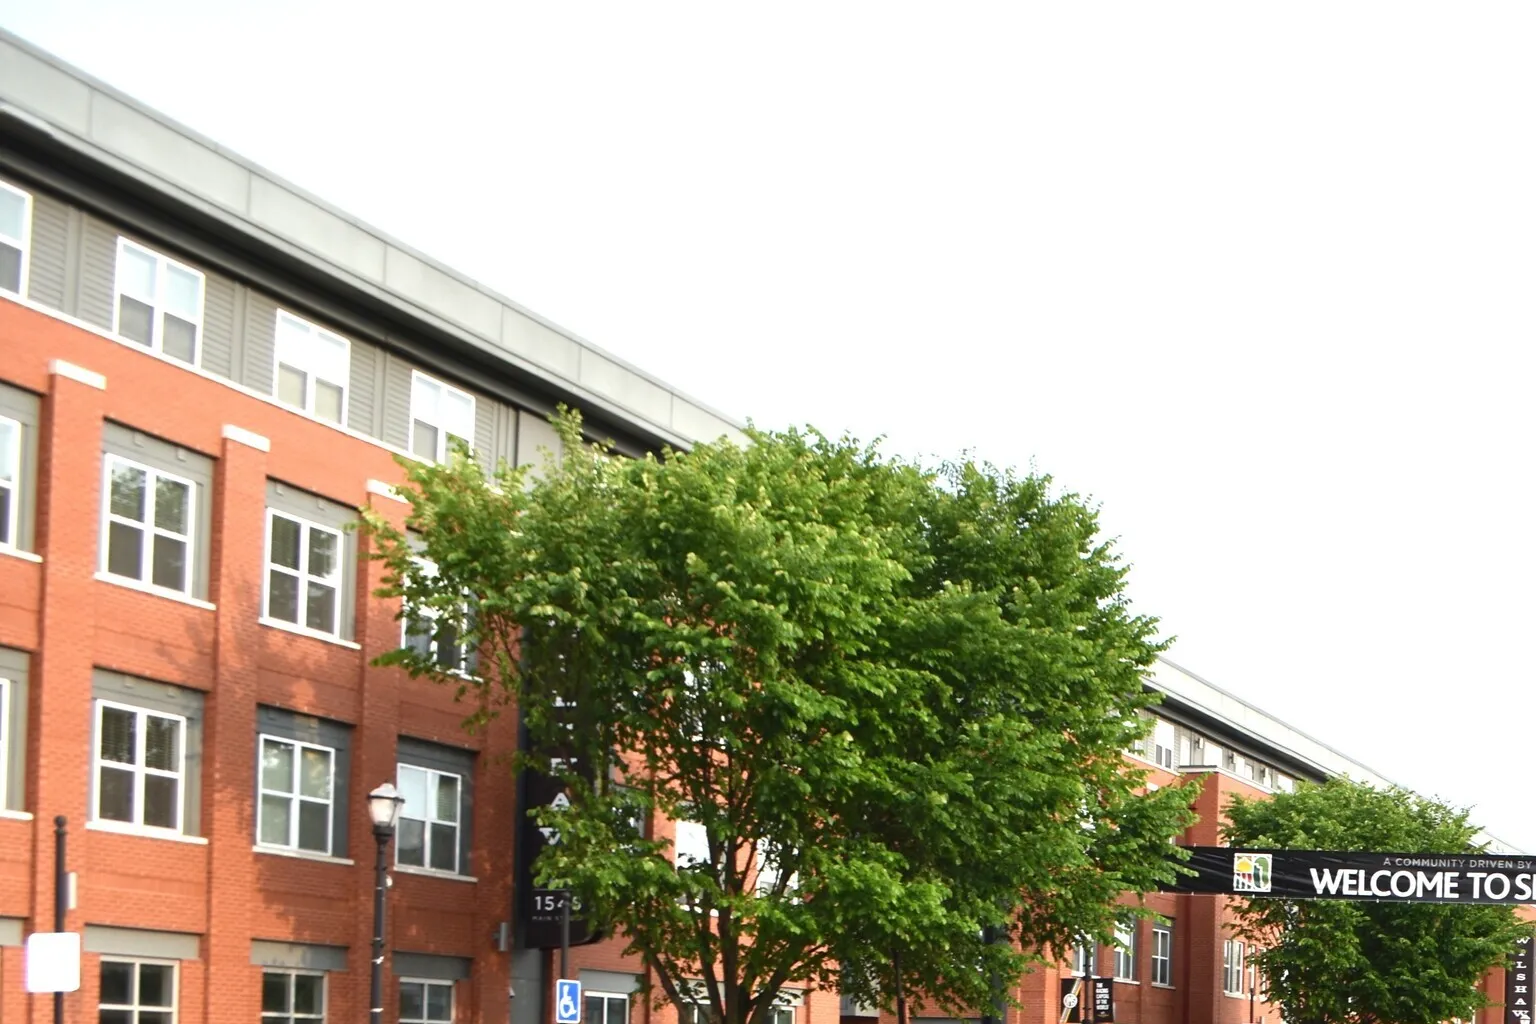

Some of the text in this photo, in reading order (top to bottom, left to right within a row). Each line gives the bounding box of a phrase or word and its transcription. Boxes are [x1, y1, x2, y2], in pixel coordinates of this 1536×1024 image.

[1383, 857, 1392, 867] A
[1395, 857, 1465, 868] COMMUNITY
[1469, 859, 1514, 870] DRIVEN
[1517, 860, 1533, 870] BY
[1309, 867, 1461, 899] WELCOME
[1466, 872, 1511, 901] TO
